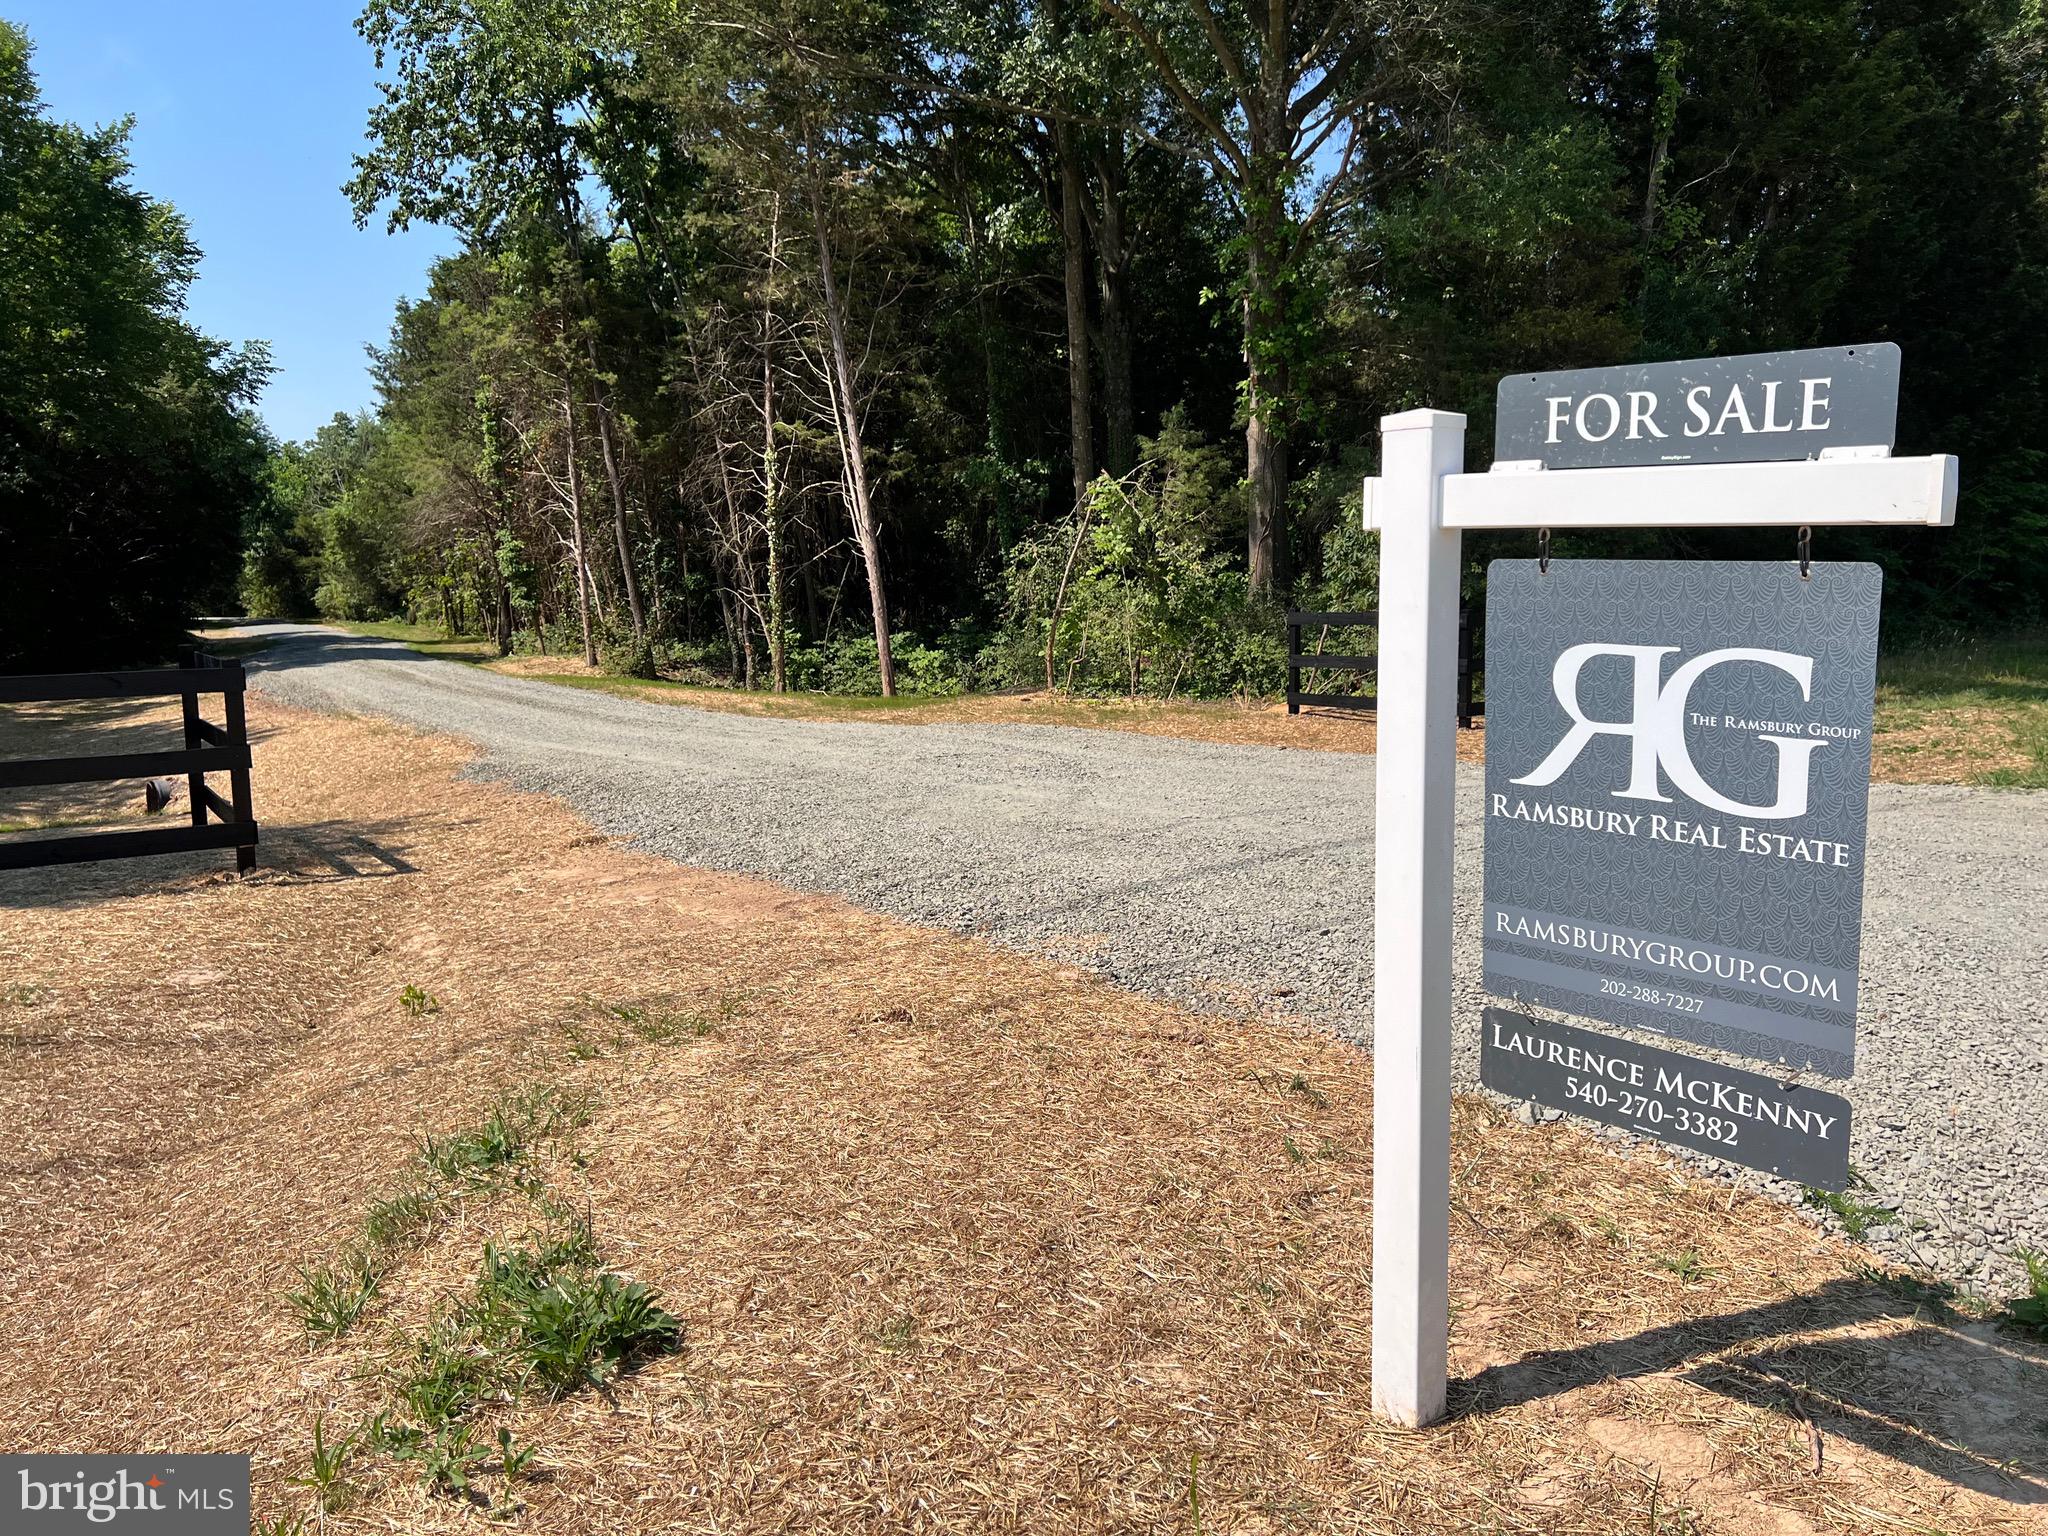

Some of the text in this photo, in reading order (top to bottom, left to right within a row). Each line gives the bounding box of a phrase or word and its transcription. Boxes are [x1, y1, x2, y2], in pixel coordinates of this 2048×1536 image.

[1544, 376, 1832, 444] FOR SALE
[1689, 712, 1861, 740] THE RAMSBURY GROUP
[1491, 793, 1850, 868] RAMSBURY REAL ESTATE
[1495, 911, 1841, 1002] RAMSBURYGROUP.COM
[1600, 979, 1704, 1014] 202-288-7227
[1492, 1024, 1644, 1087] LAURENCE
[1565, 1077, 1738, 1146] 540-270-3382
